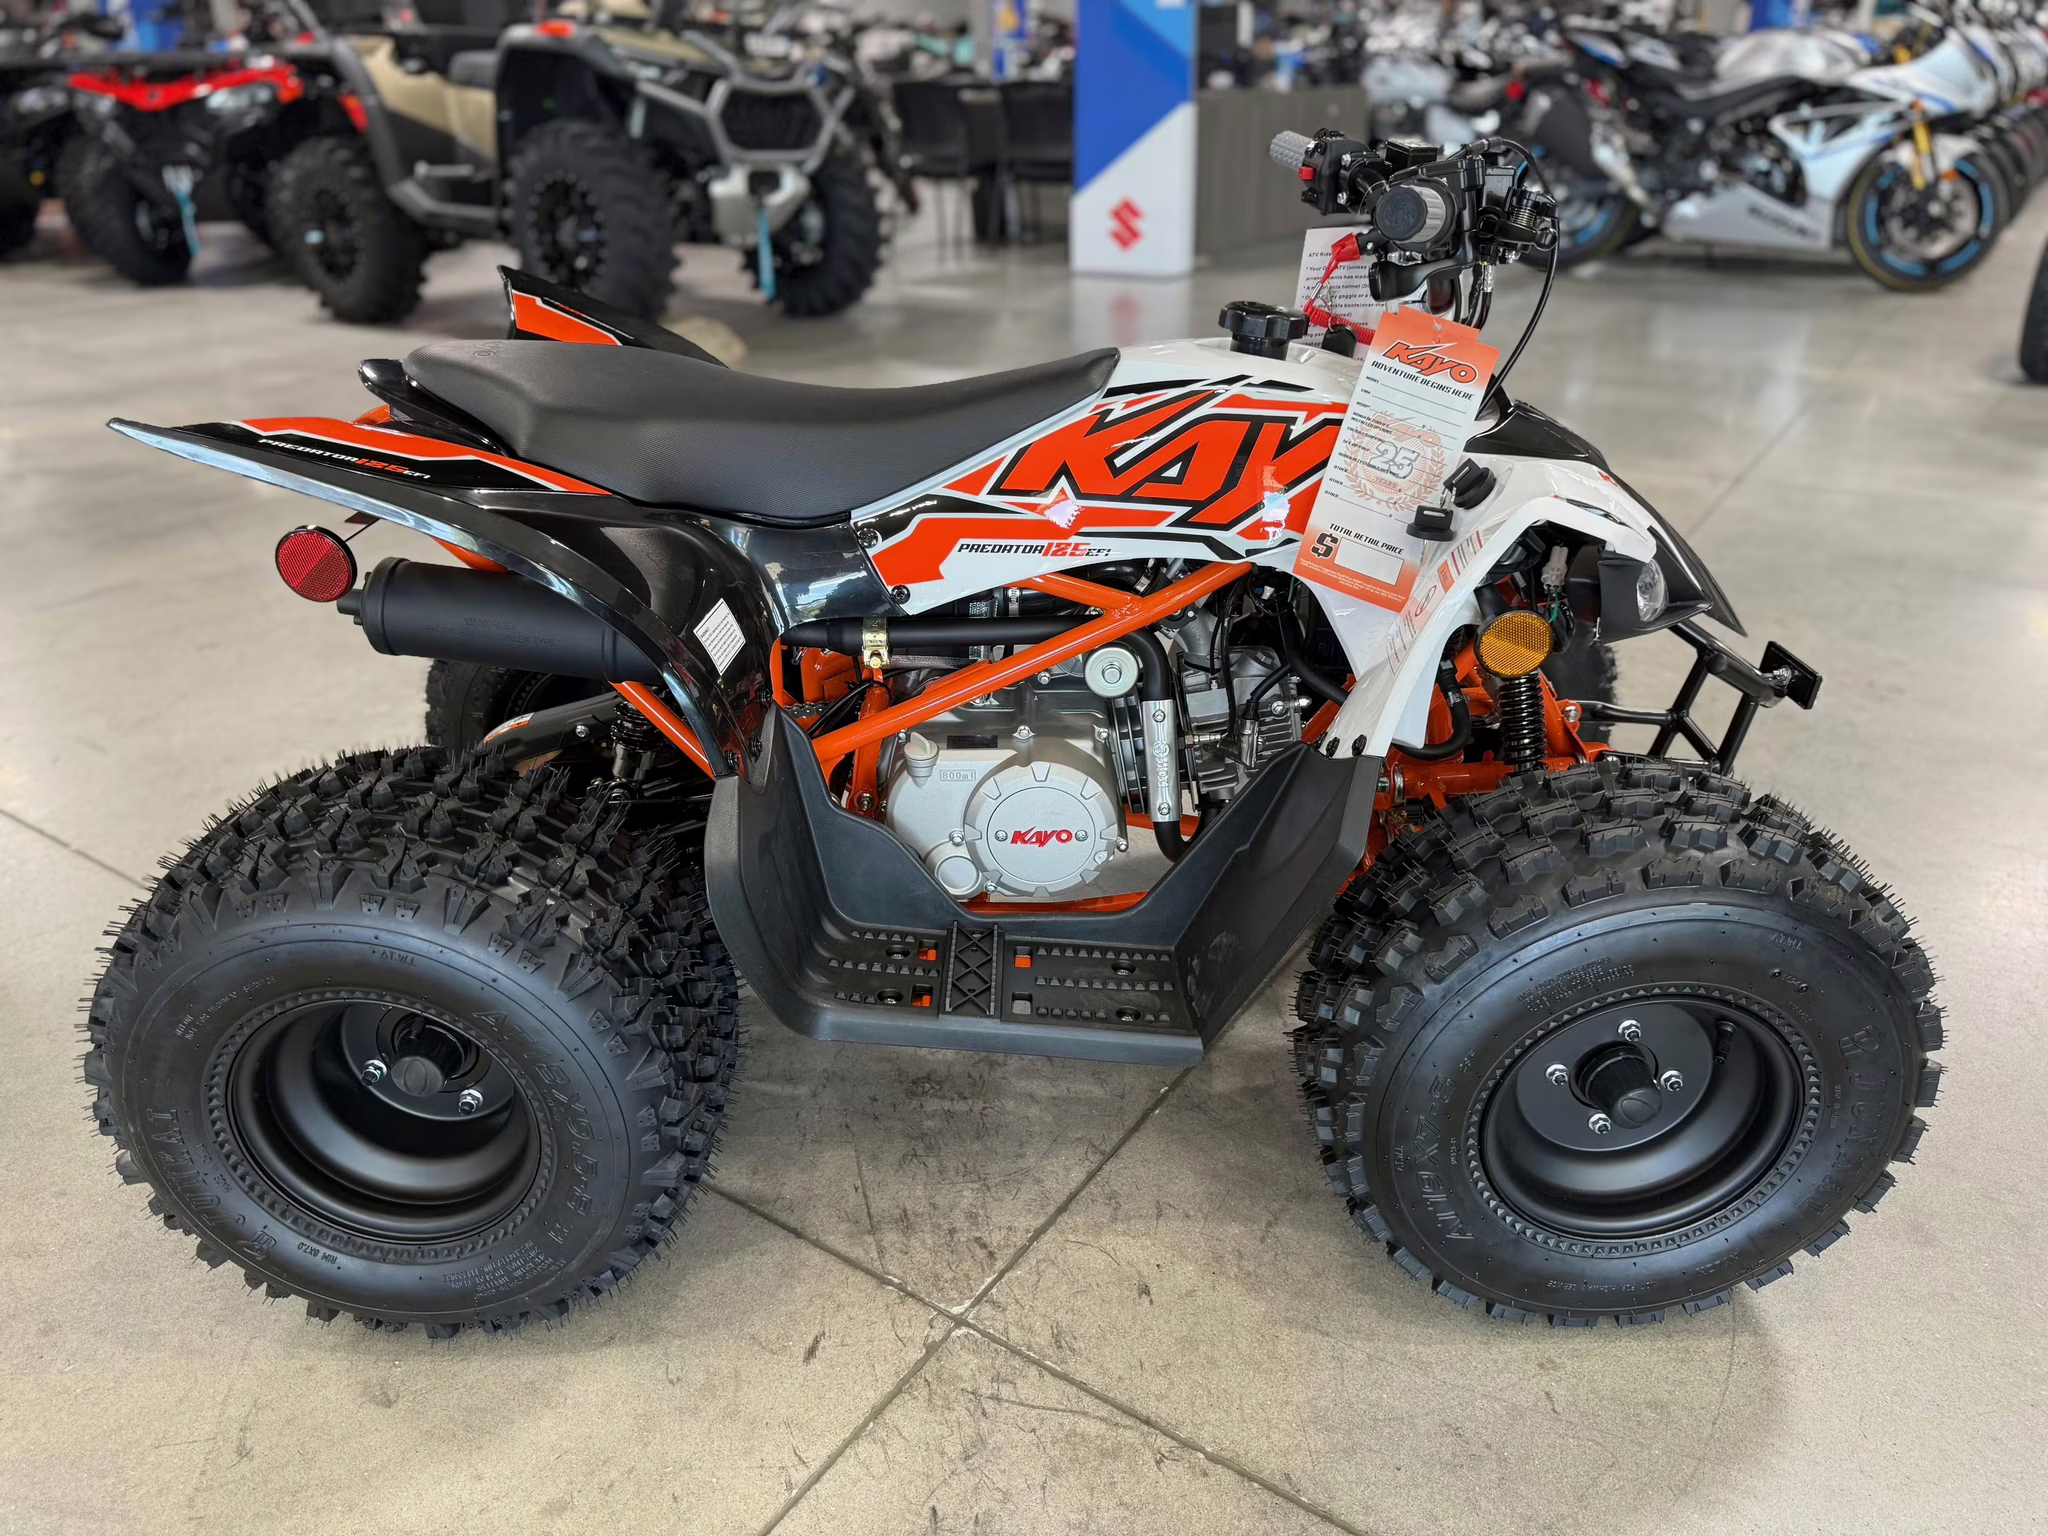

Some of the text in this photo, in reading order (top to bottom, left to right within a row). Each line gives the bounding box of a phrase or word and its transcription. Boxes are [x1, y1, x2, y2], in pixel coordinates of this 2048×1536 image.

[1381, 340, 1478, 384] KAYO
[1371, 360, 1474, 401] ADVENTURE BEGINS HERE
[988, 388, 1342, 531] KAY
[1368, 441, 1421, 479] 25
[1310, 532, 1339, 558] $
[1329, 523, 1404, 555] TOTAL RETAIL PRICE
[942, 771, 974, 780] 800ml
[1010, 825, 1072, 848] KAYO
[297, 1242, 338, 1264] RIM 8X7.0
